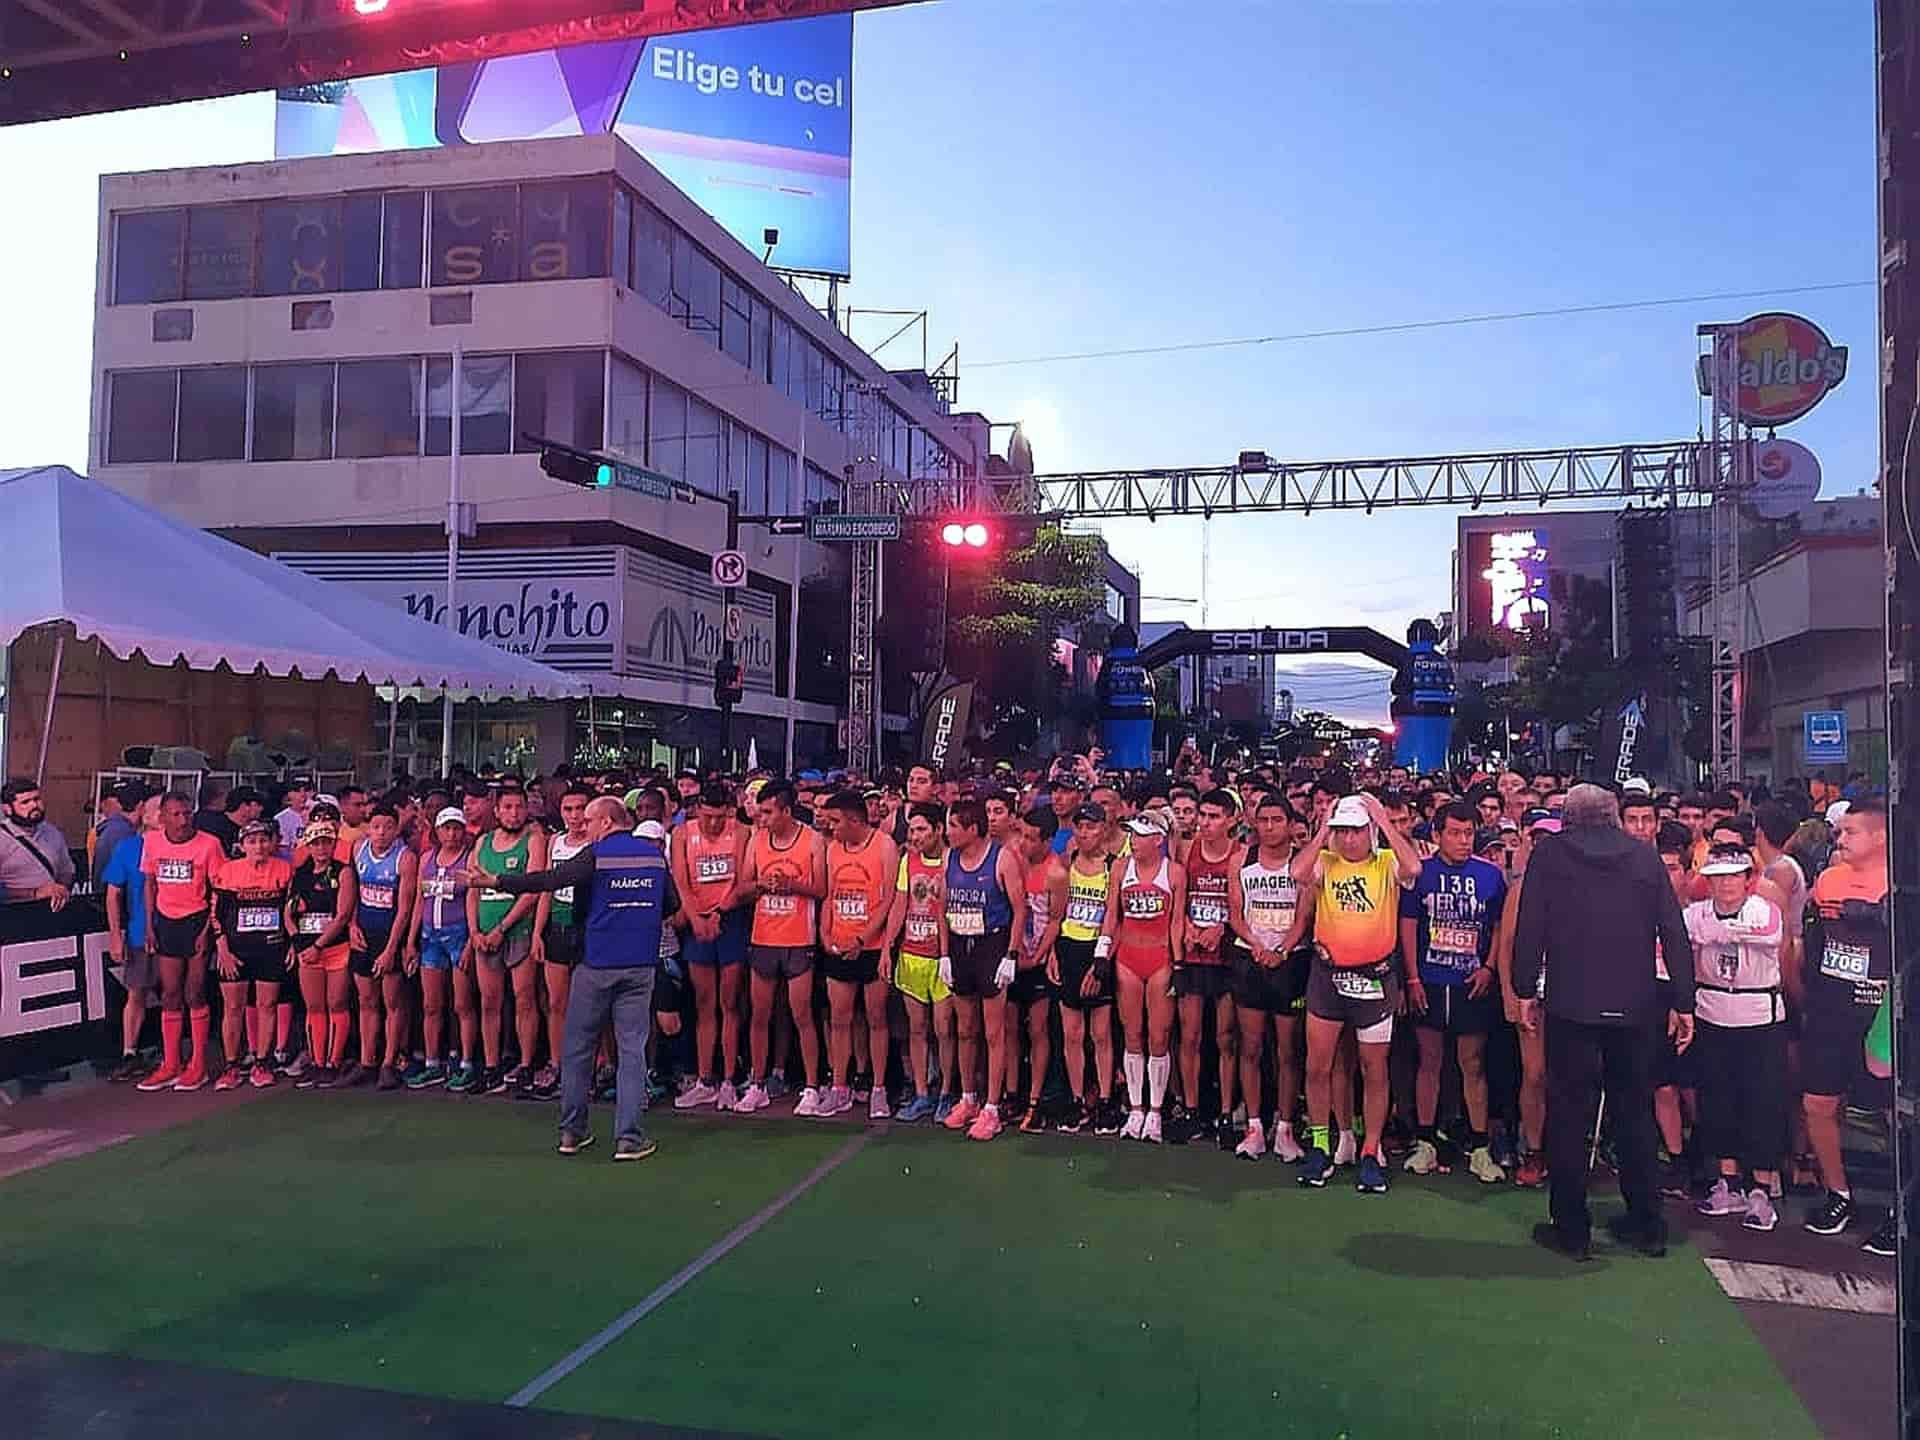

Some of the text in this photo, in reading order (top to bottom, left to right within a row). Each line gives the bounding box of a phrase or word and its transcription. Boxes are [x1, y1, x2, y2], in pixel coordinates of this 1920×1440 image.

[653, 47, 843, 108] Elige tu cel
[1698, 345, 1848, 396] aldo's
[1211, 631, 1329, 650] SALIDA
[1439, 874, 1475, 895] 138
